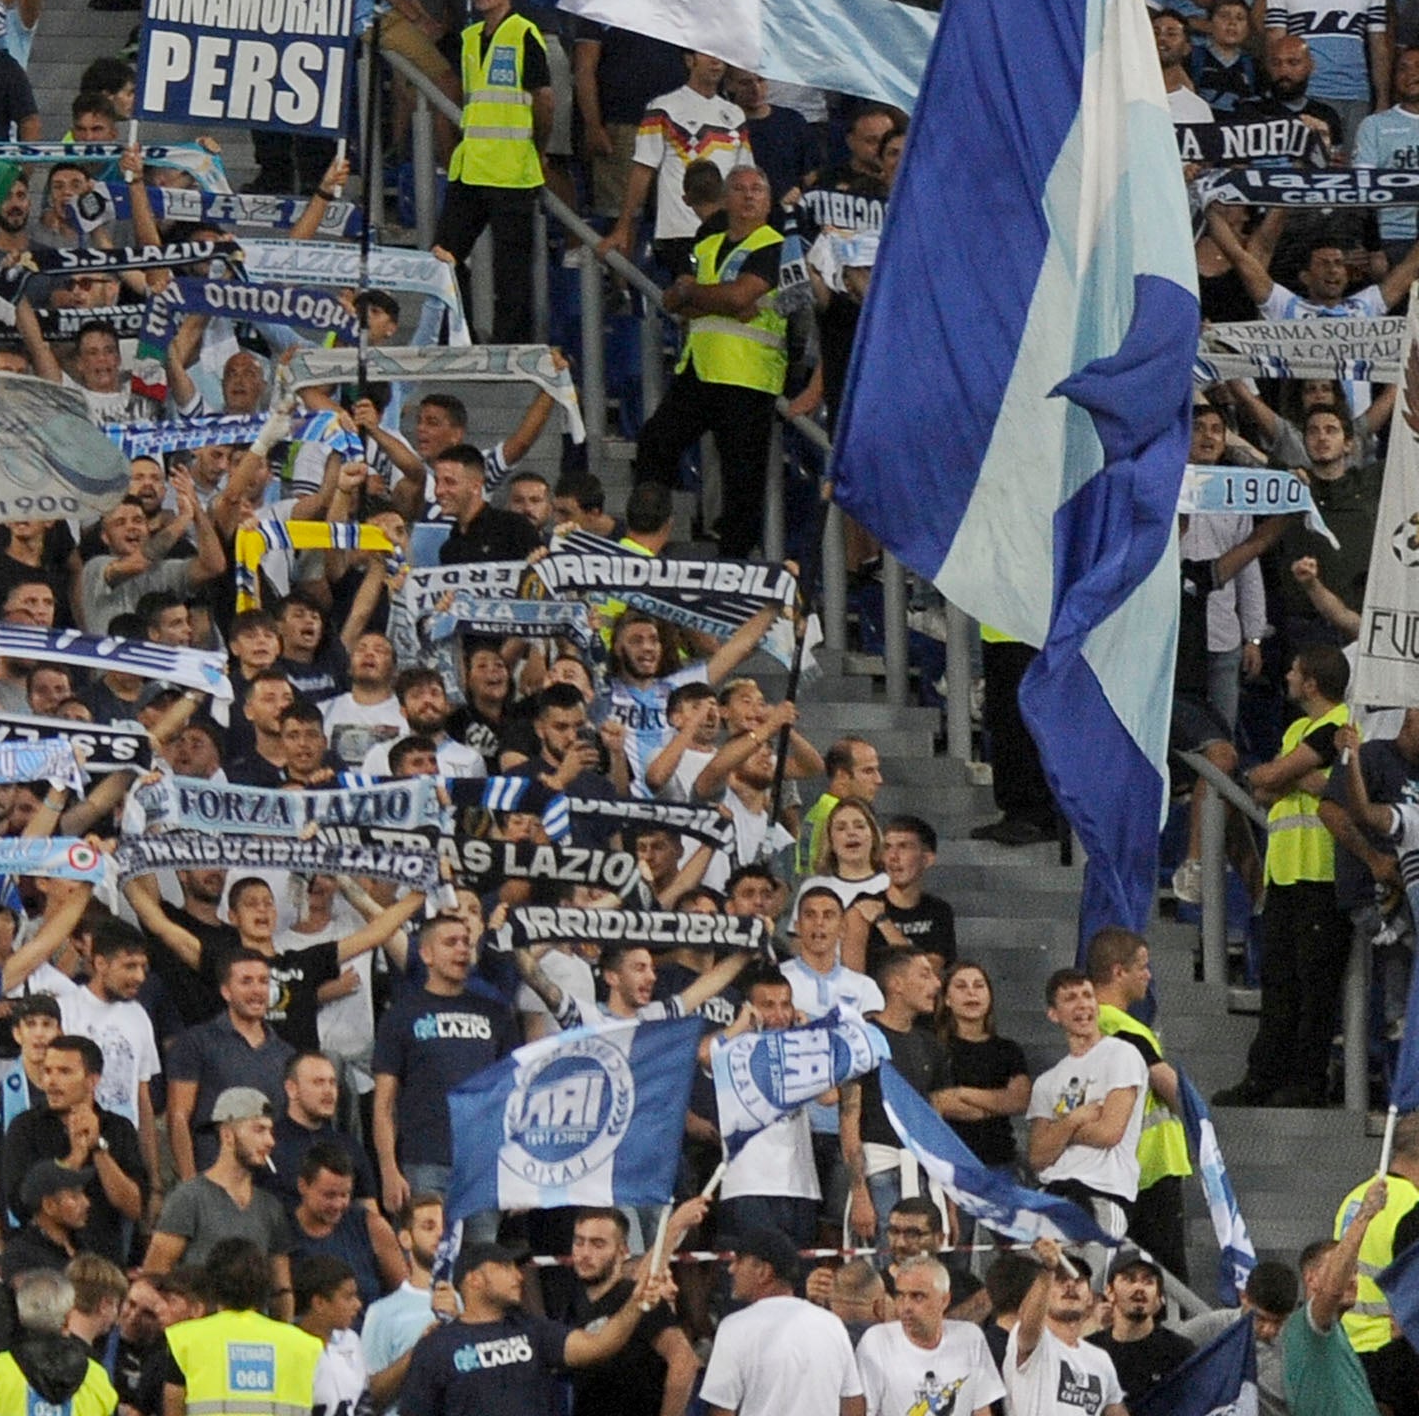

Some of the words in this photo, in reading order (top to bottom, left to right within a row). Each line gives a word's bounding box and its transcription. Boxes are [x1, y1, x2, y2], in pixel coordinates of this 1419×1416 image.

[142, 27, 347, 130] PERSI
[1220, 117, 1312, 160] NORD
[1245, 168, 1419, 189] lazio
[1280, 187, 1394, 205] calcio
[57, 246, 119, 268] S.S.
[124, 241, 216, 263] LAZIO
[1244, 324, 1316, 341] PRIMA
[1223, 477, 1303, 505] 1900
[178, 788, 293, 826] FORZA
[304, 788, 412, 827] LAZIO
[137, 838, 325, 865] IRRIDUCIBILI
[339, 844, 424, 879] LAZIO
[502, 844, 636, 889] LAZIO
[514, 905, 763, 948] IRRIDUCIBILI
[435, 1020, 493, 1041] LAZIO
[479, 1342, 533, 1369] LAZIO
